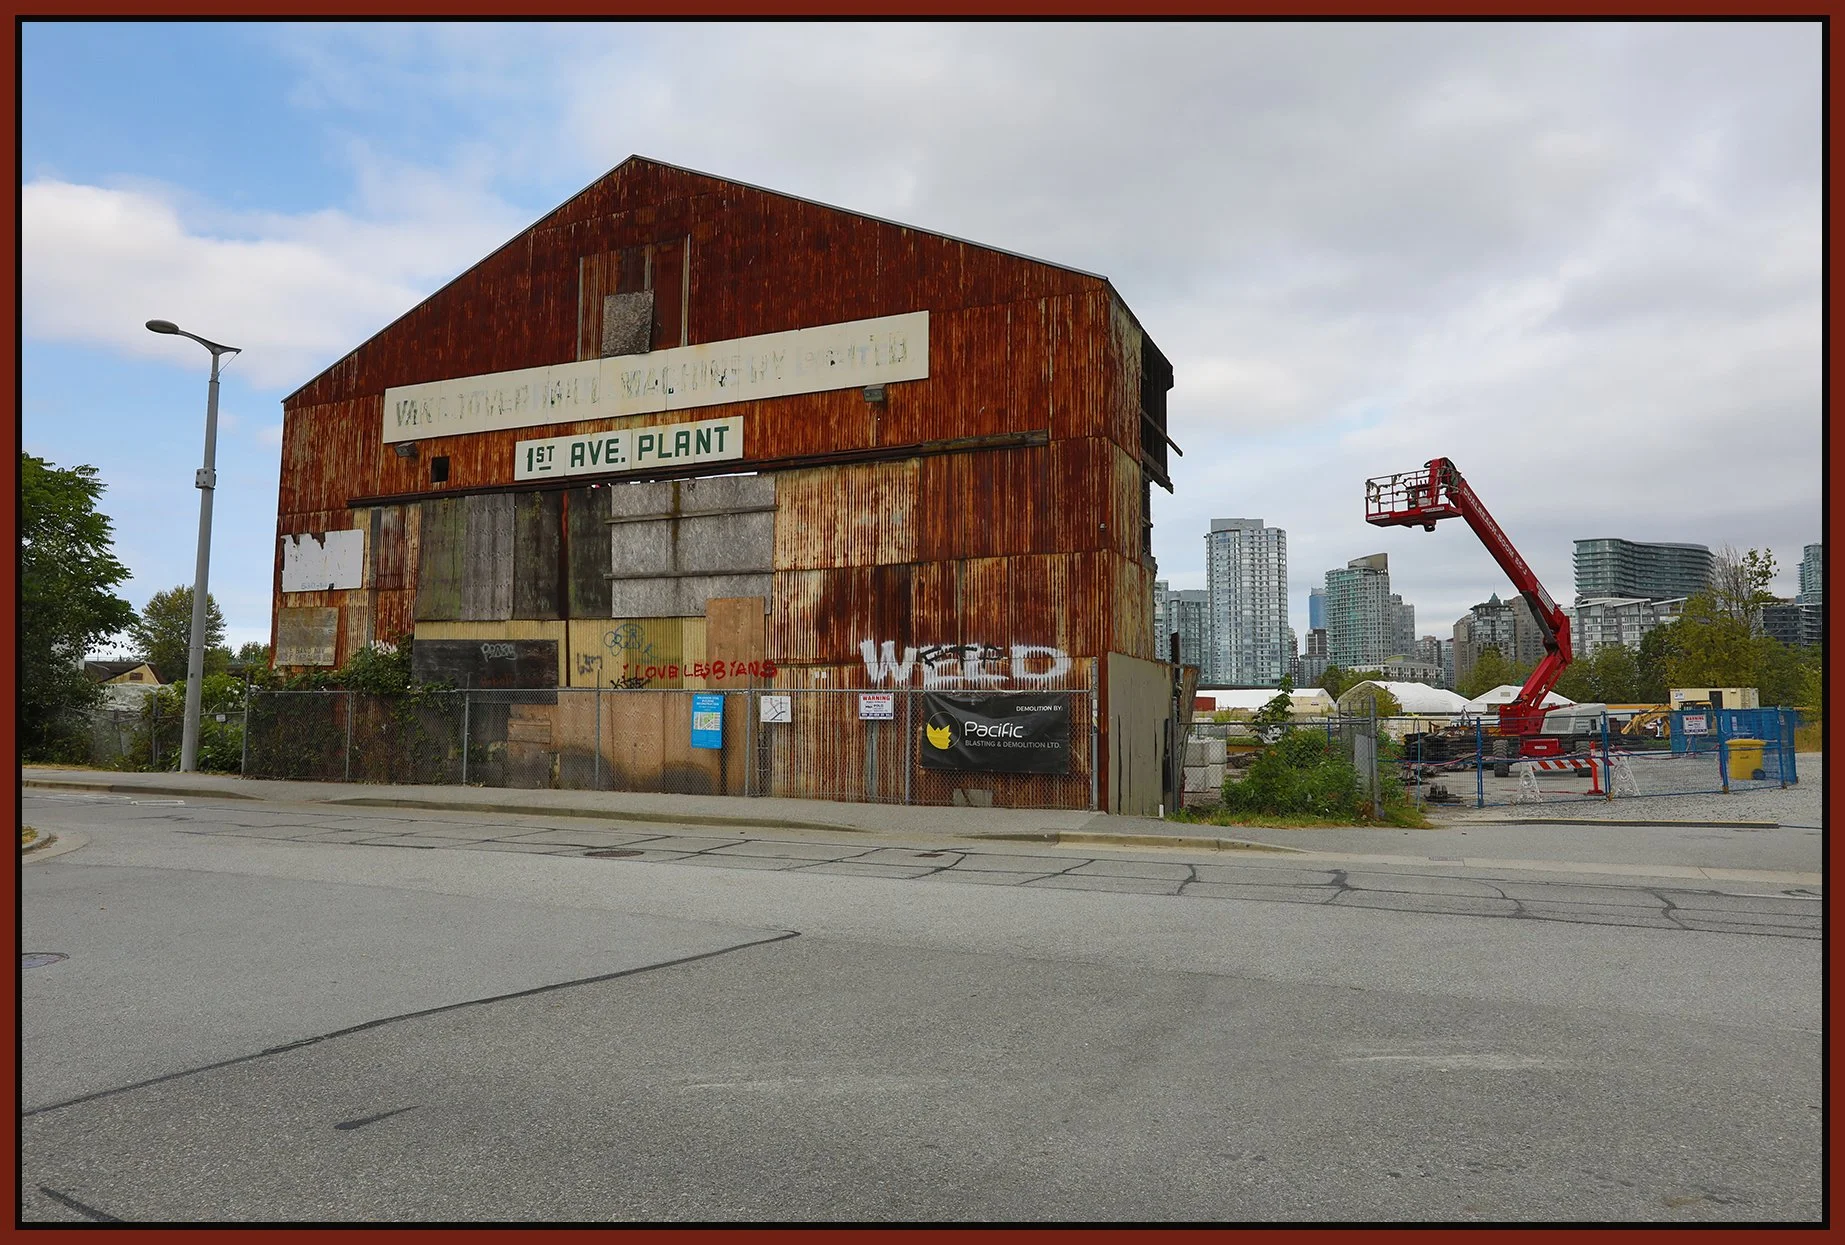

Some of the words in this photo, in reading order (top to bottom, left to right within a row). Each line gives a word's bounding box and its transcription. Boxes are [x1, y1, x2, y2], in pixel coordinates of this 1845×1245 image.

[526, 445, 555, 472] 1ST
[570, 438, 626, 468] AVE.
[638, 425, 730, 461] PLANT
[635, 664, 679, 681] LOVE
[860, 639, 1073, 690] WEED
[964, 721, 1024, 739] Pacific
[965, 740, 996, 748] BLASTING
[997, 740, 1002, 748] &
[1003, 740, 1045, 749] DEMOLITION
